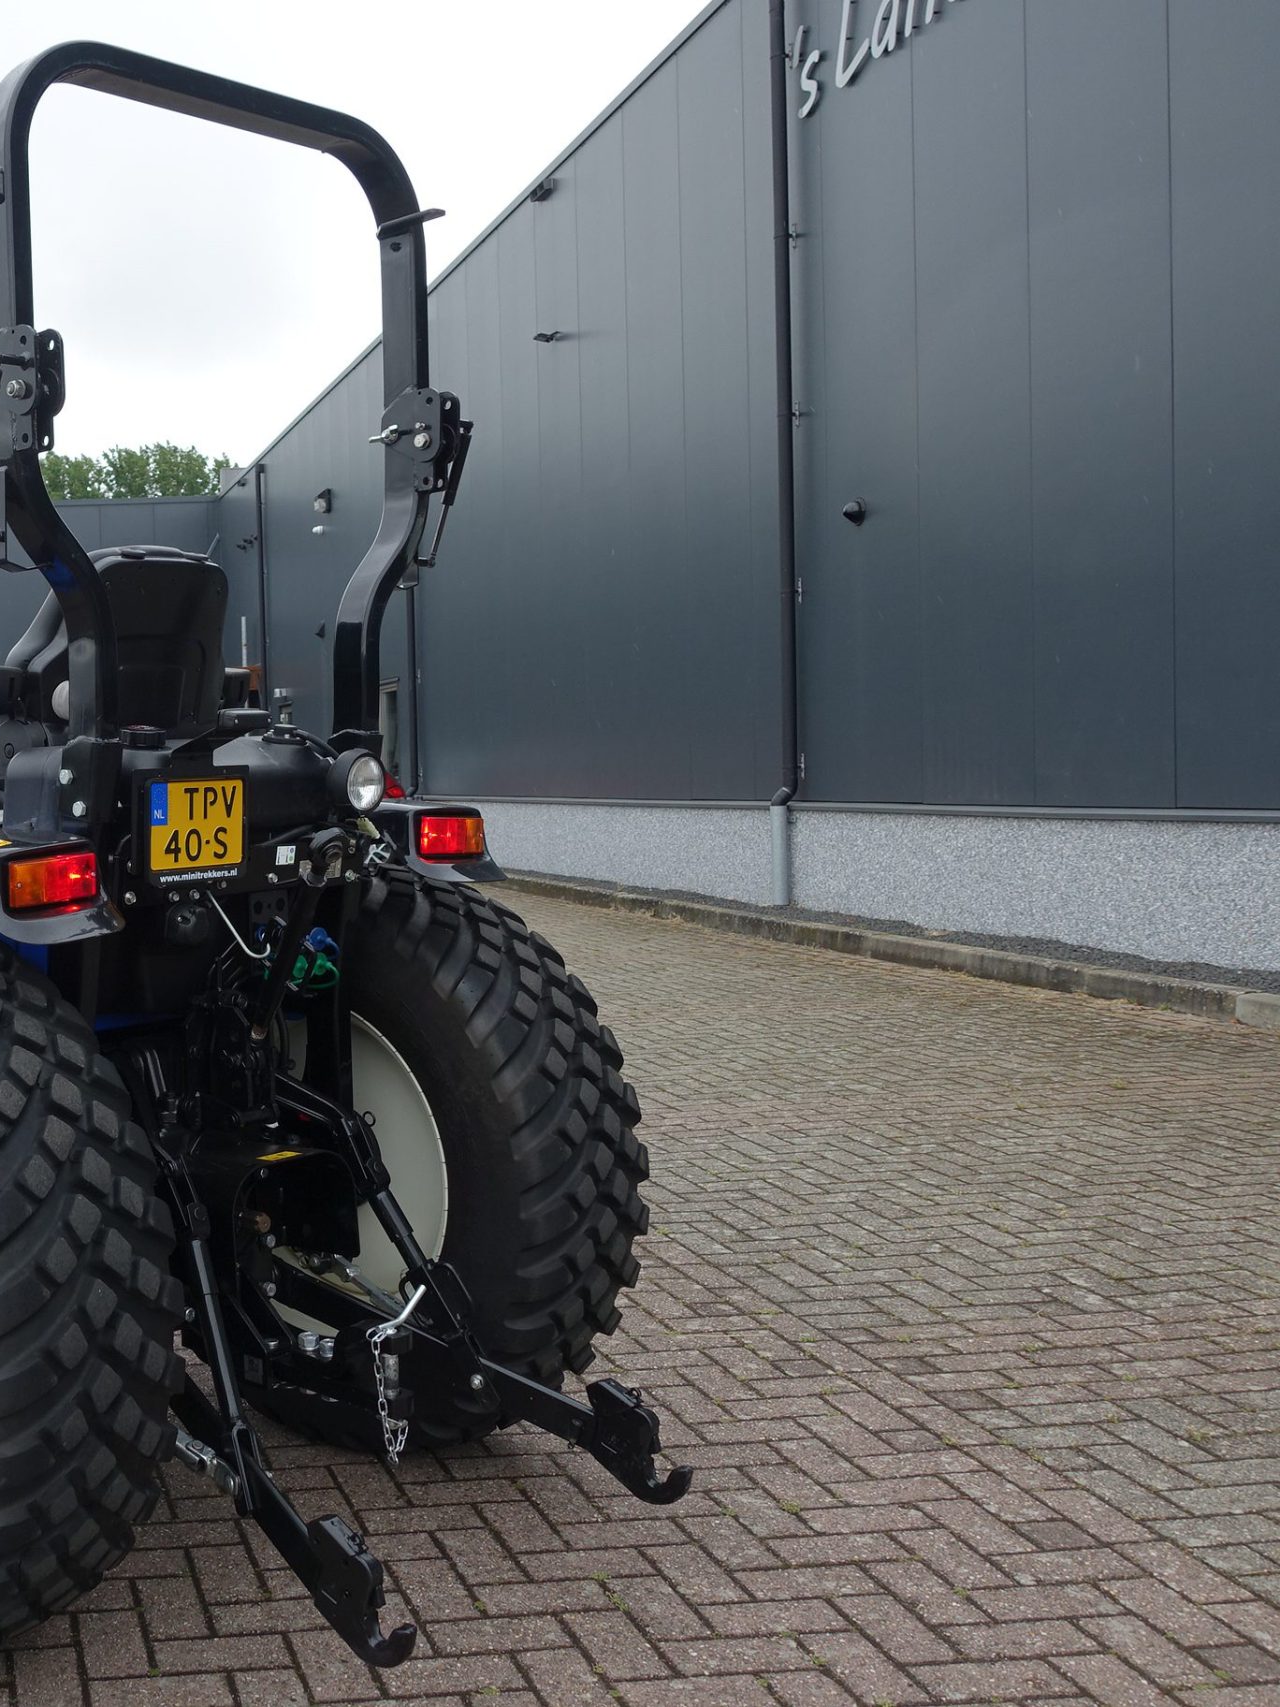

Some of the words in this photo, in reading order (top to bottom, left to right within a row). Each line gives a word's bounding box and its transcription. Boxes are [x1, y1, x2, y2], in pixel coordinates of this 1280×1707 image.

[791, 24, 820, 119] 's
[835, 0, 966, 89] Lan
[153, 809, 165, 820] NL
[183, 785, 237, 821] TPV
[159, 867, 238, 883] www.minitrekkers.nl
